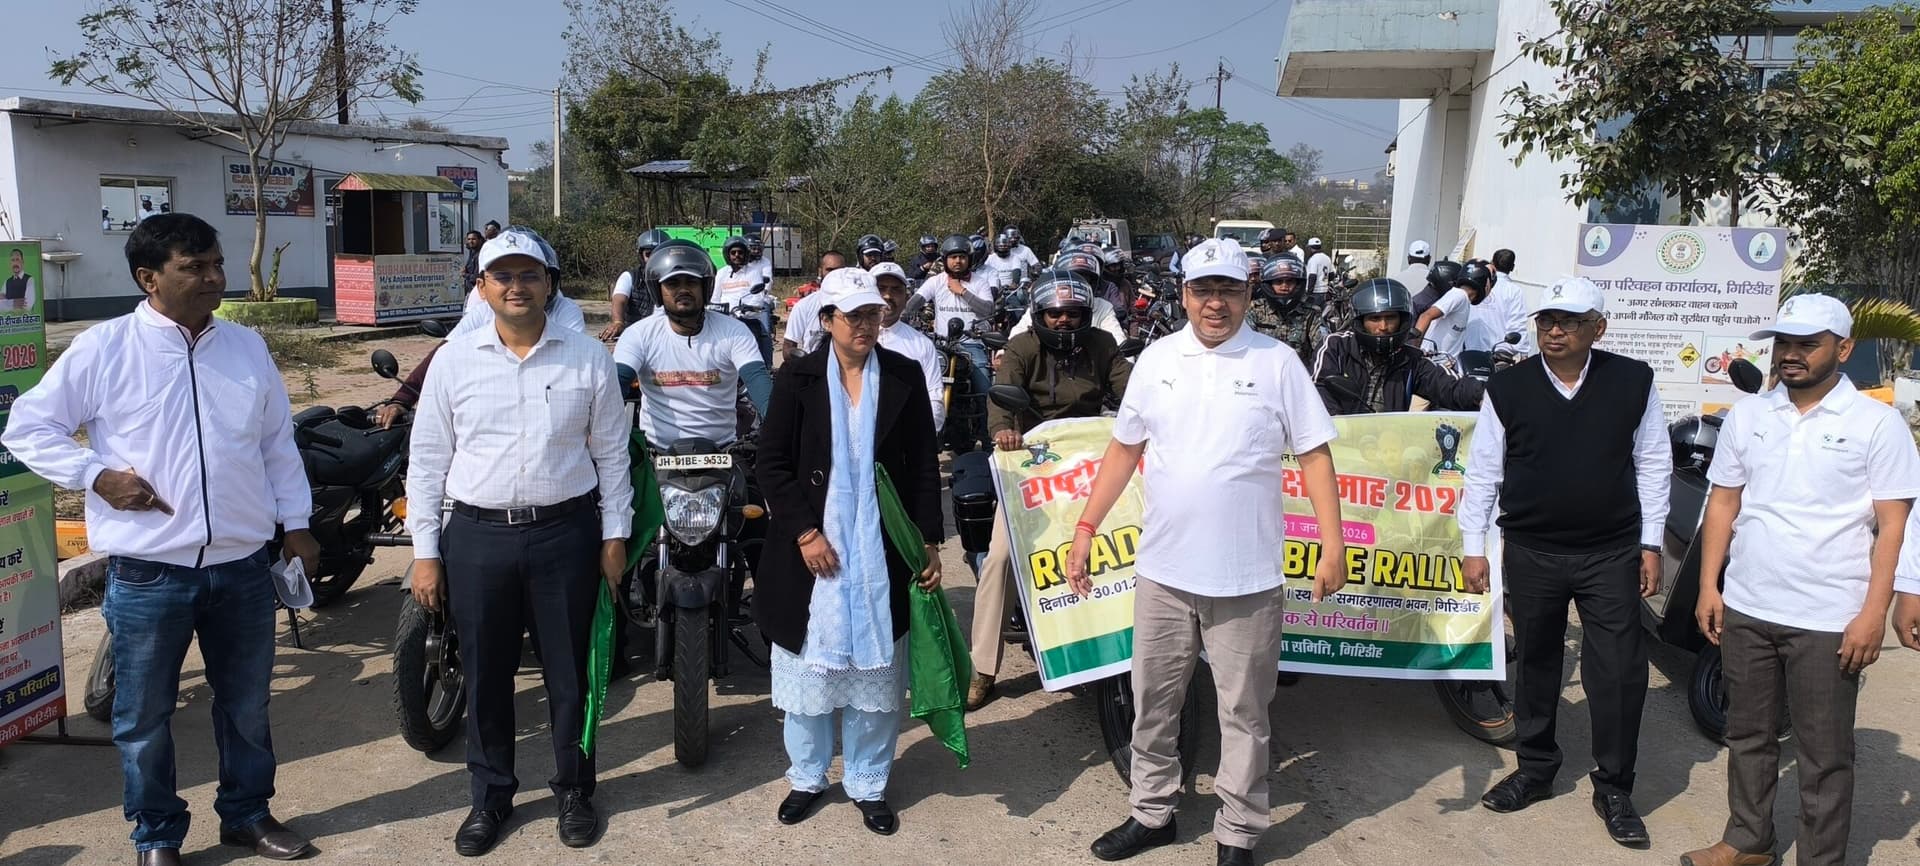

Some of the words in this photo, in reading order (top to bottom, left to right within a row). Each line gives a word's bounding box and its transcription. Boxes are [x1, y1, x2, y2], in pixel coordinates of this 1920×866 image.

[229, 164, 295, 176] SUAM
[1615, 277, 1662, 291] परिवहन
[1726, 280, 1775, 295] गिरिडीह
[4, 343, 36, 369] 2026
[0, 391, 15, 404] 026
[1394, 480, 1464, 515] 202
[1283, 540, 1369, 585] BIE
[1093, 575, 1137, 599] 30.01.2
[1336, 593, 1402, 610] समाहरणालय
[1434, 597, 1481, 614] गिरिडीह
[1304, 610, 1318, 627] से
[1340, 641, 1384, 659] गिरिडीह
